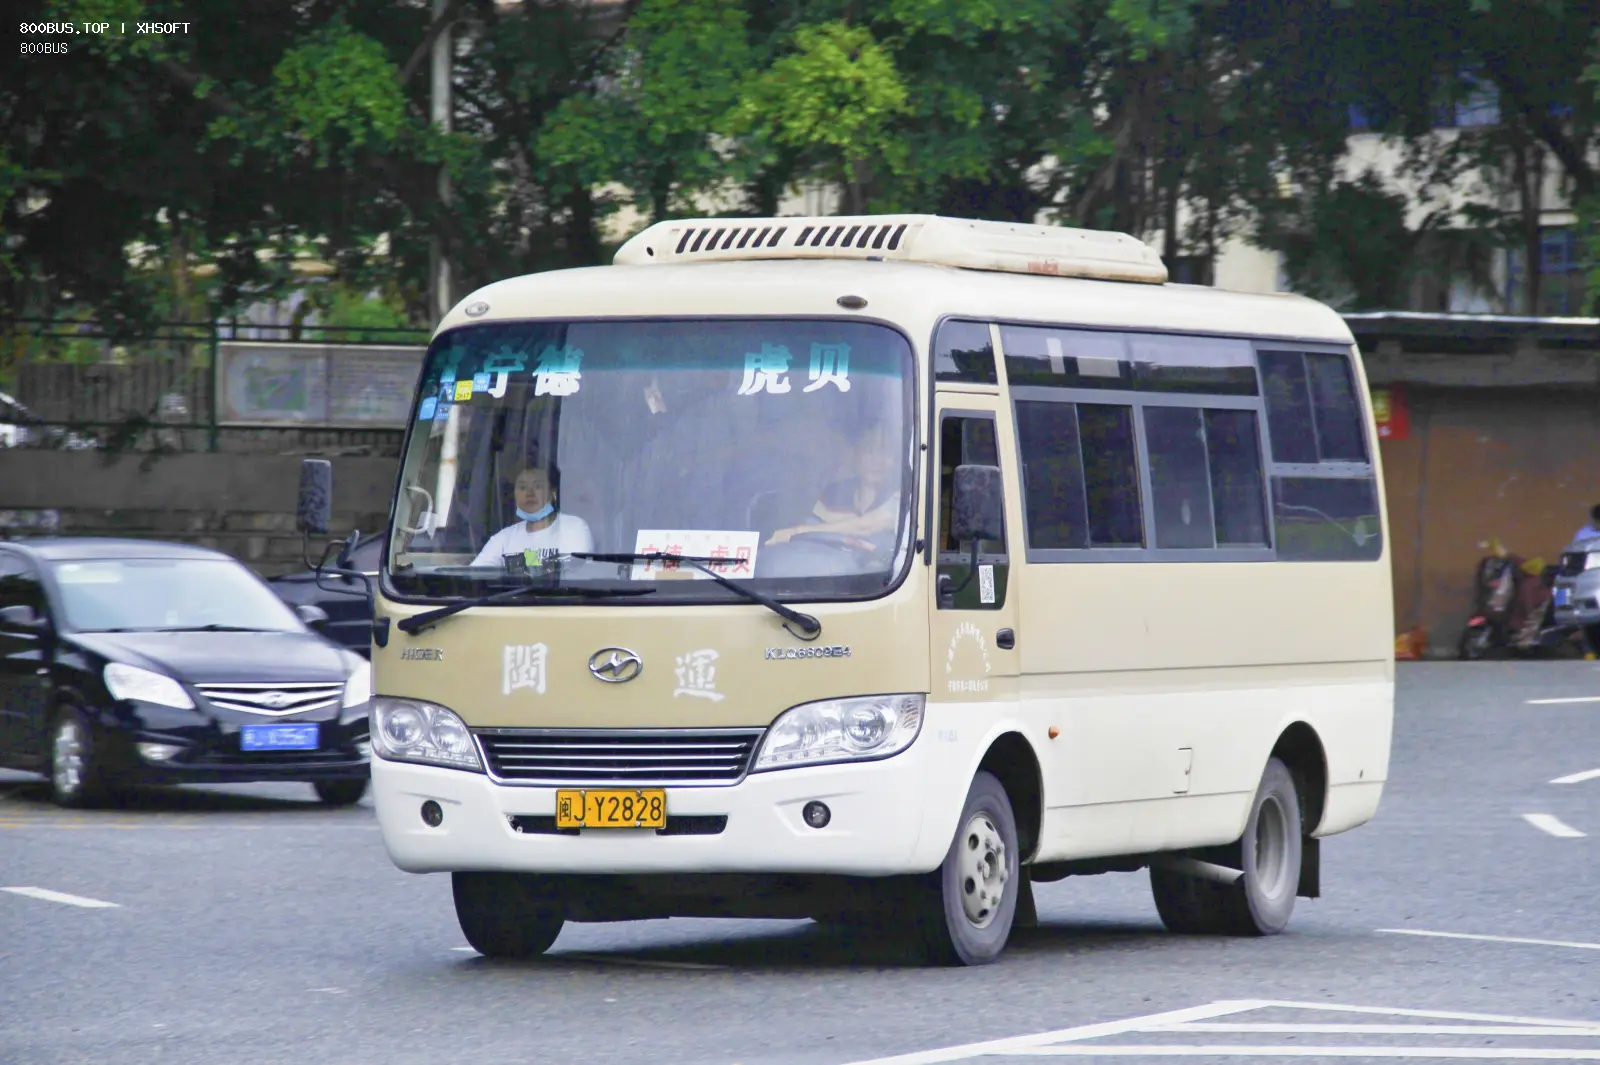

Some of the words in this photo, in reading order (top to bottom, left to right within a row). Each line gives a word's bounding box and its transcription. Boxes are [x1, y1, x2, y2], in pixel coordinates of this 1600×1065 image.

[484, 344, 585, 398] 宁德
[737, 341, 852, 395] 虎贝
[706, 545, 752, 574] 虎贝
